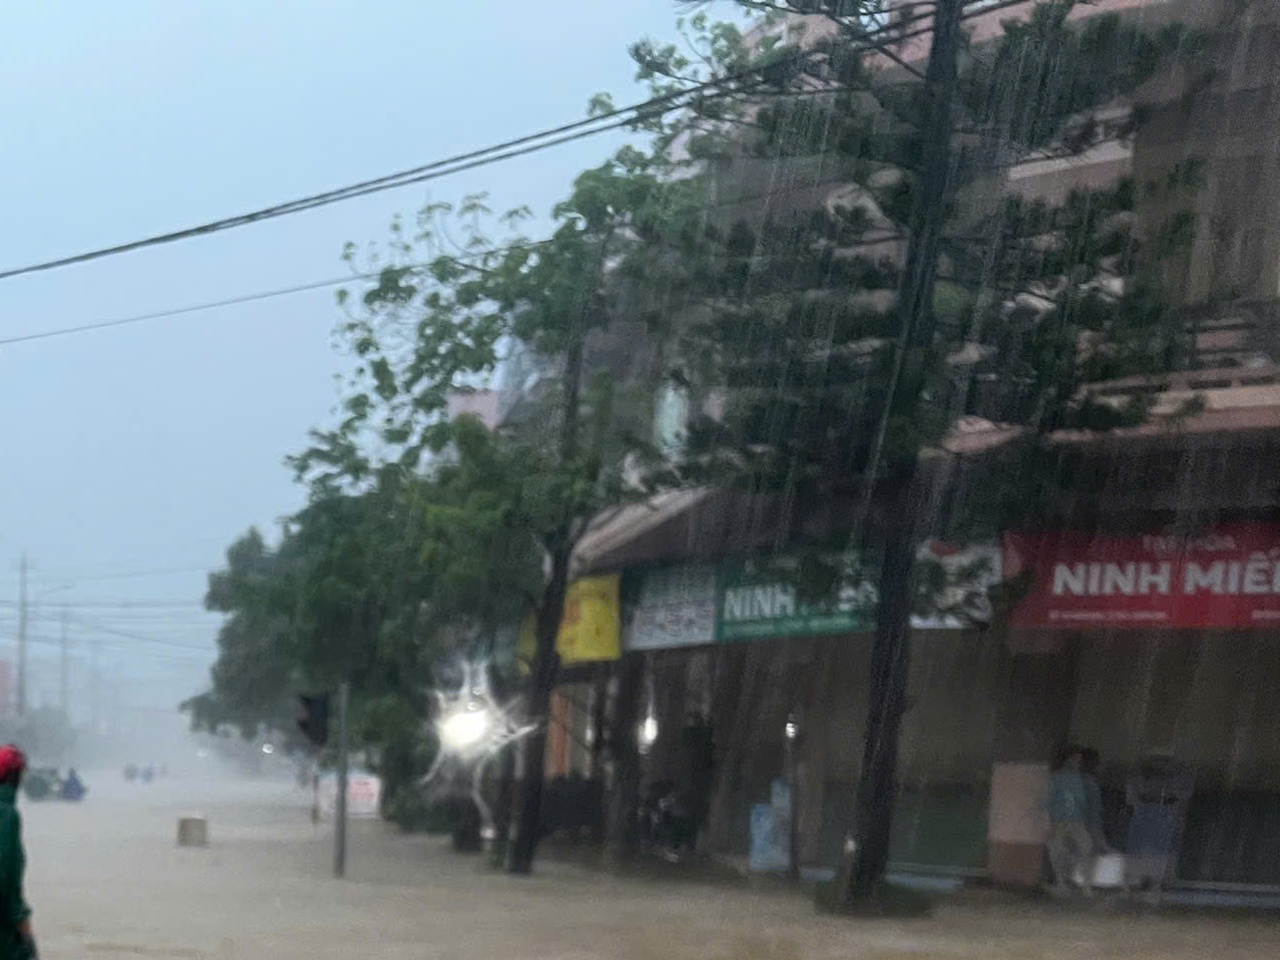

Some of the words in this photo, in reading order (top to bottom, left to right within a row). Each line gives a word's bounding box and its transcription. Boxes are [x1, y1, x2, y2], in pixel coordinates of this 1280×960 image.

[1053, 561, 1169, 595] NINH
[1183, 548, 1280, 595] MIẾ
[724, 583, 795, 620] NINH
